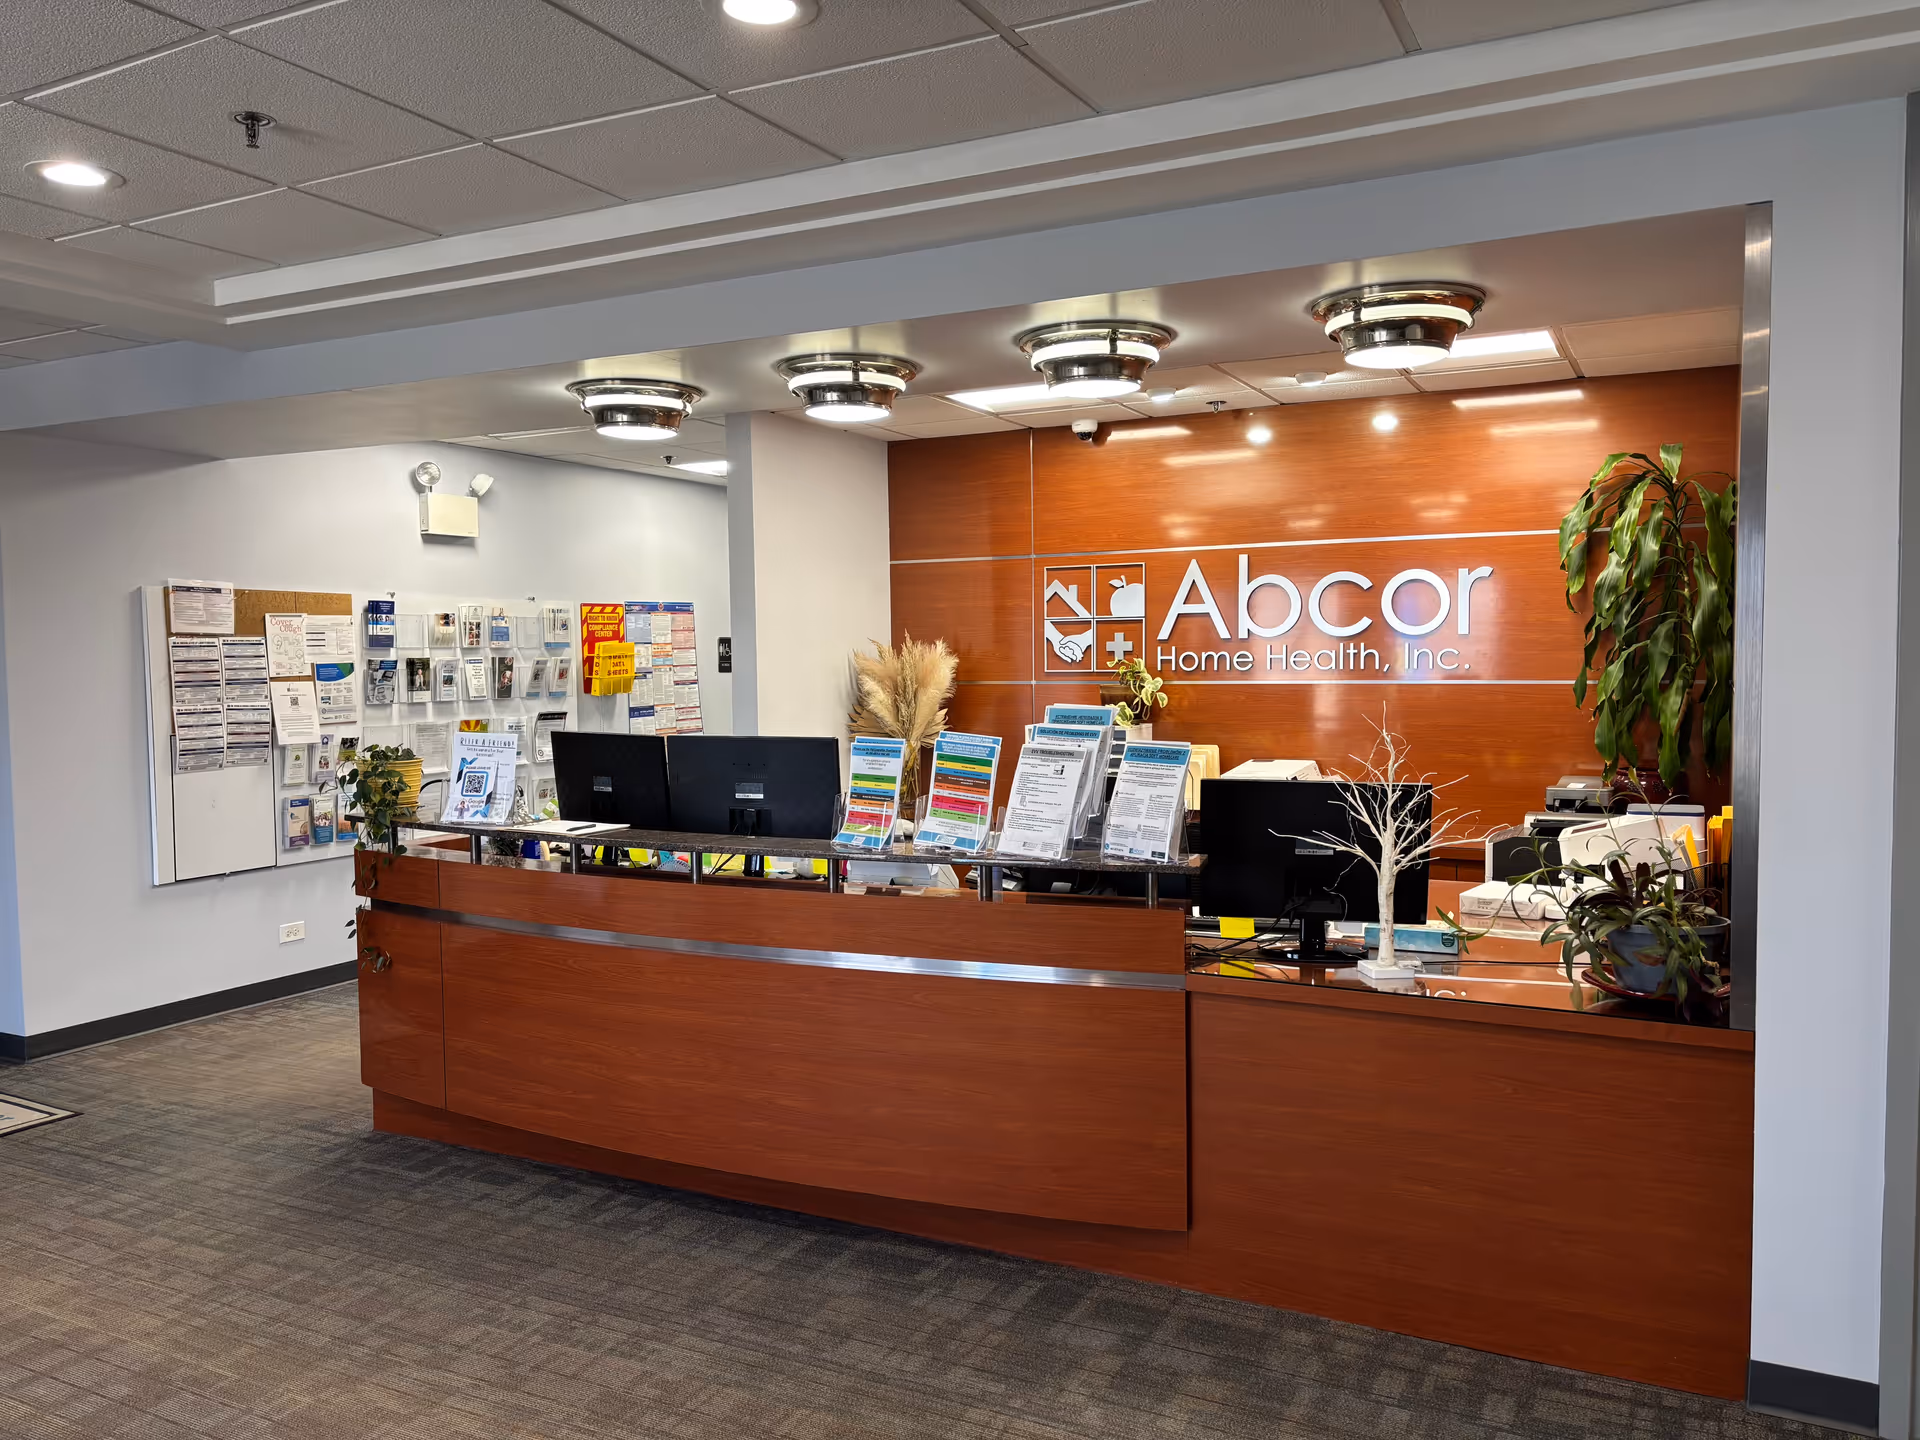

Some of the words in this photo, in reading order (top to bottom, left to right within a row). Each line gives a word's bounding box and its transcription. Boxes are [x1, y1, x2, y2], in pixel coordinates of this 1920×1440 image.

[1156, 554, 1495, 641] Abcor
[270, 616, 293, 626] Cover
[279, 624, 302, 634] Cough
[1157, 645, 1254, 672] Home
[1266, 643, 1391, 674] Health,
[1404, 642, 1472, 671] Inc.
